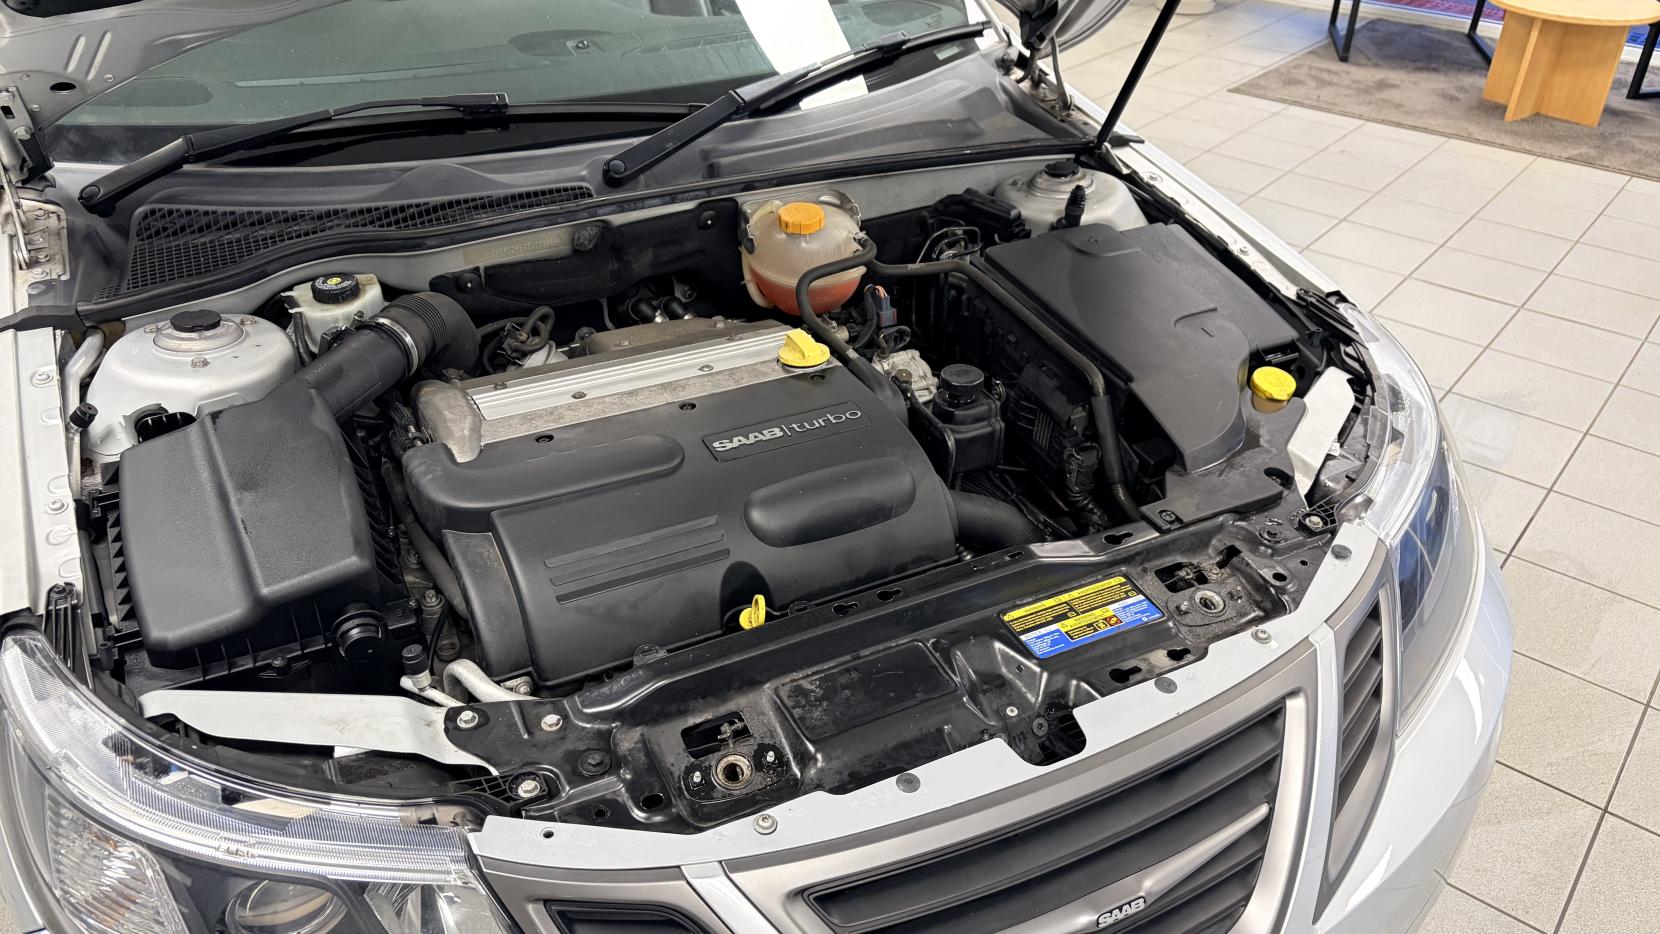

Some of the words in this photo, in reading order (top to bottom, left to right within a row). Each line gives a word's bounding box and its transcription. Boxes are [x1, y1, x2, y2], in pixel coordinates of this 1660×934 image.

[712, 427, 784, 452] SAAB
[789, 410, 862, 432] turbo
[1098, 897, 1147, 928] SAAB
